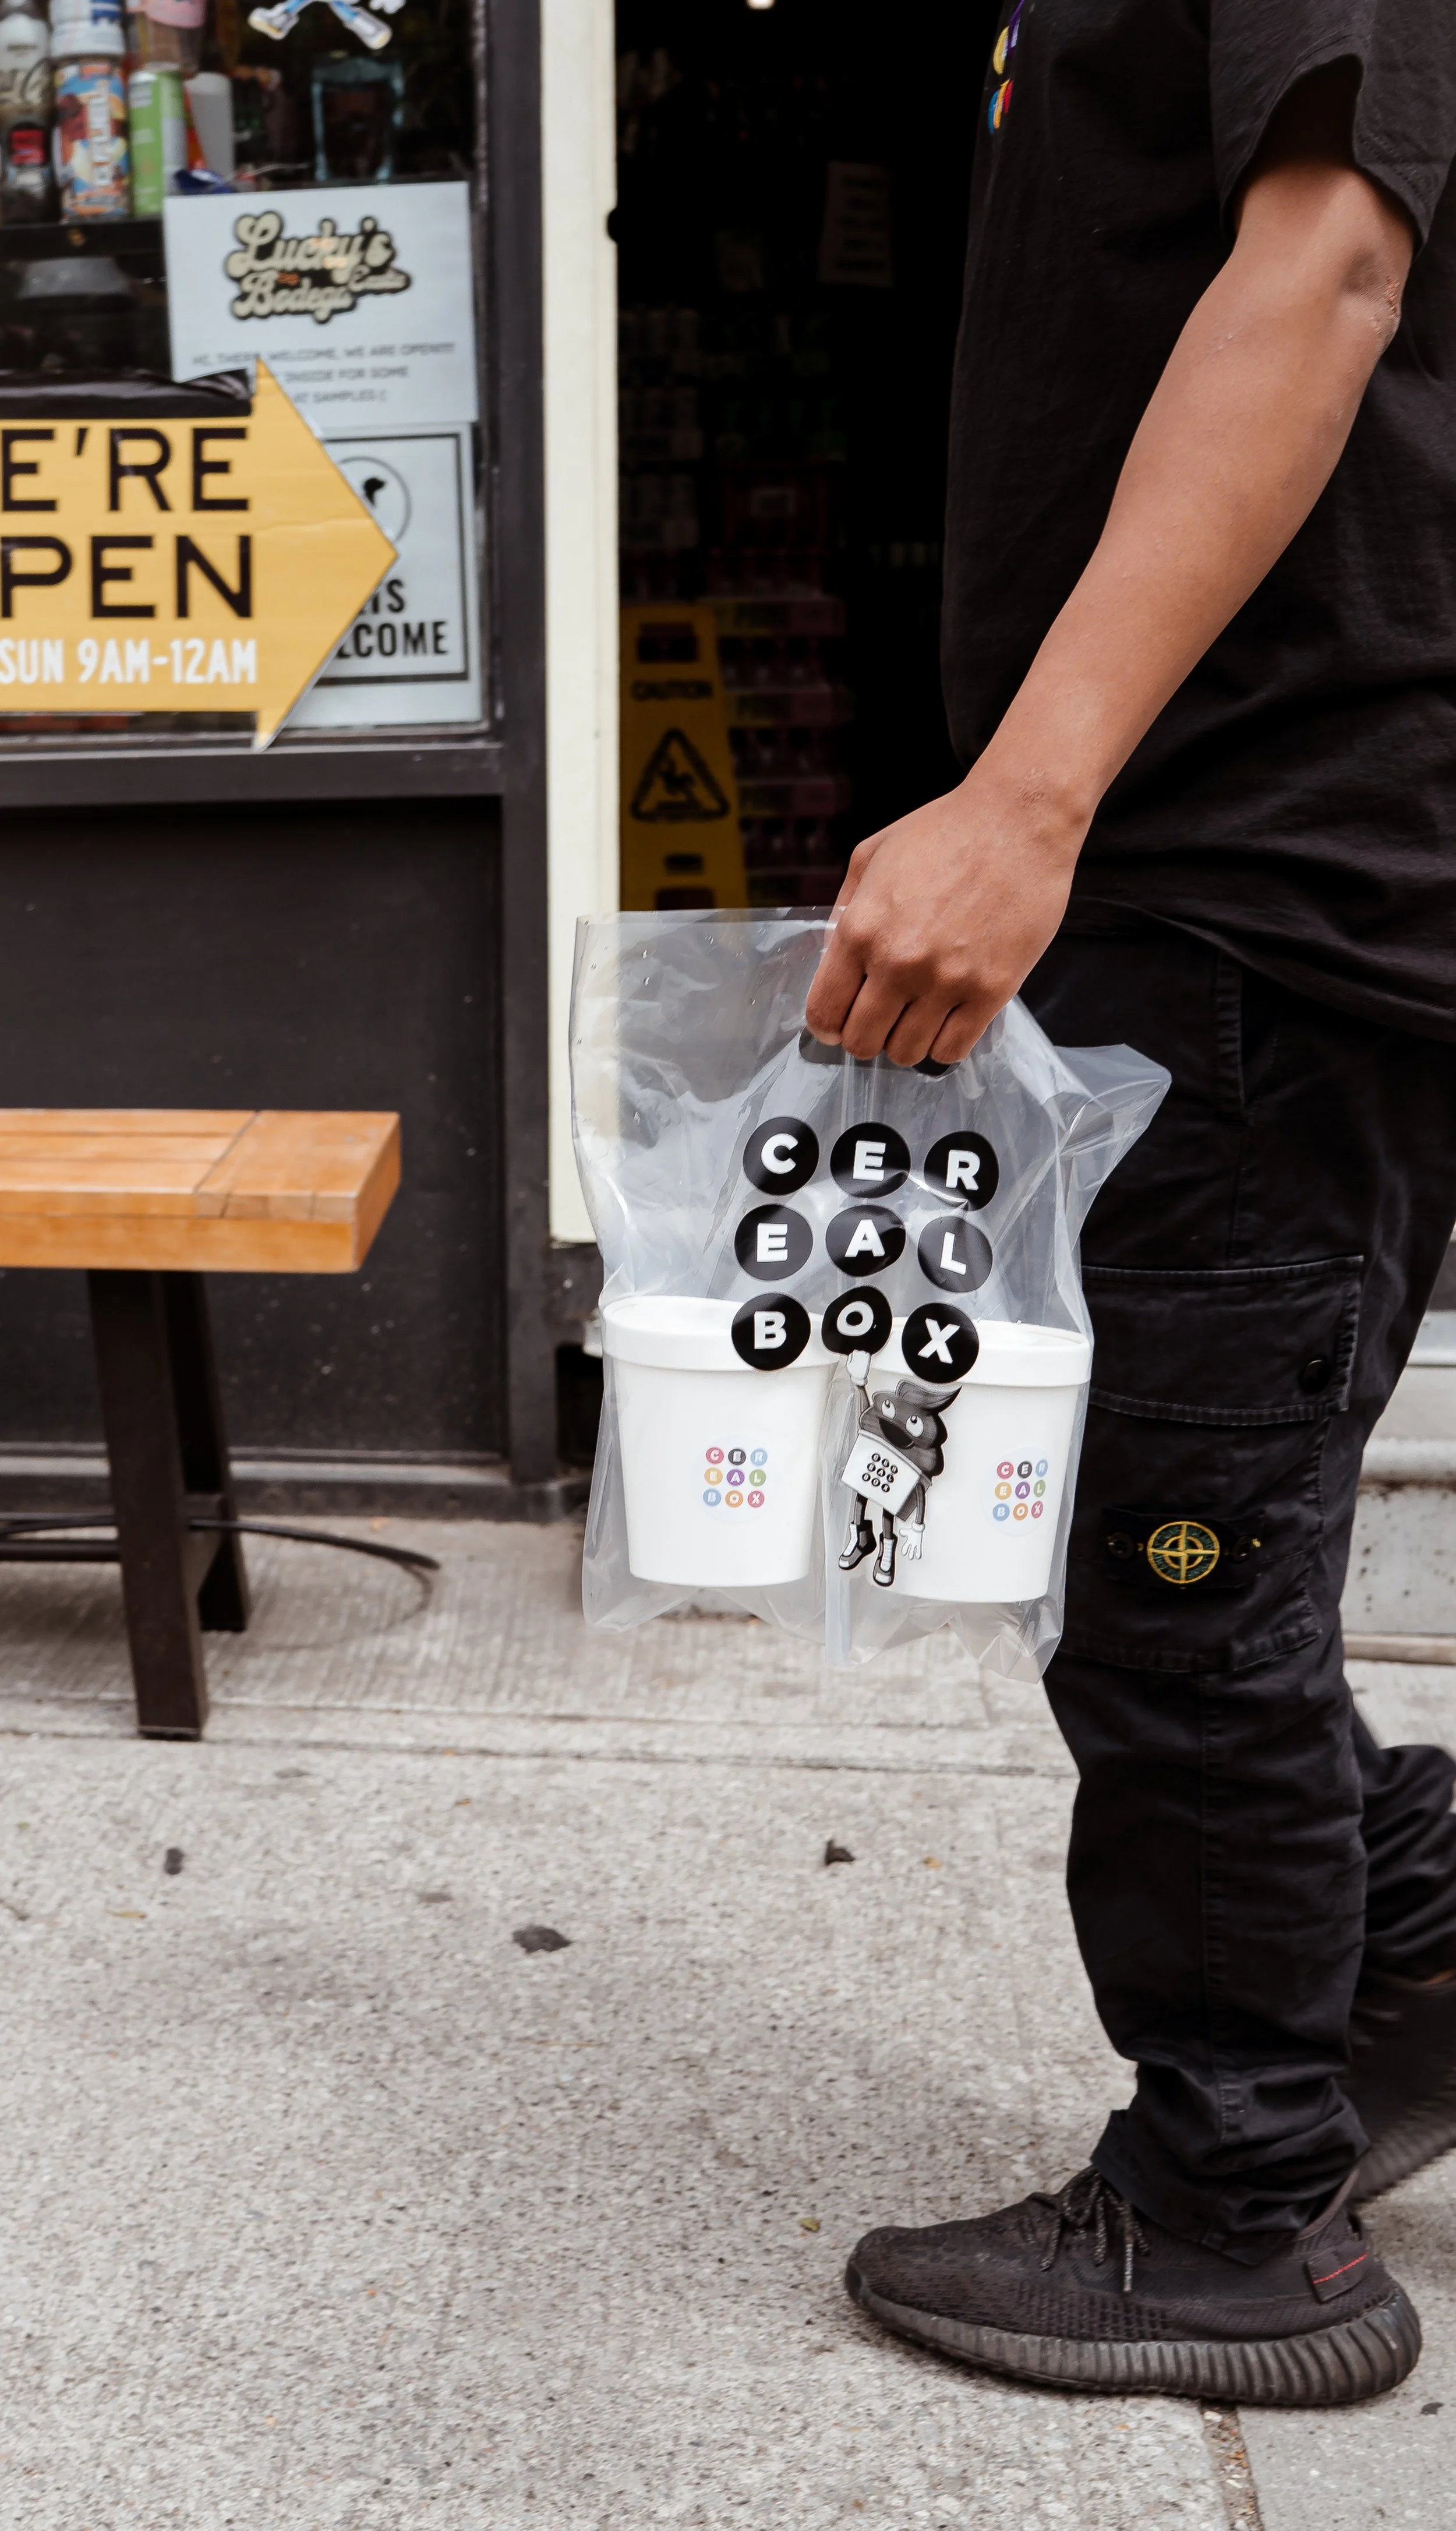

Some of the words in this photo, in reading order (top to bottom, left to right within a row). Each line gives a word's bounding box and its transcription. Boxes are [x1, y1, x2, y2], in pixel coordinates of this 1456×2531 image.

[226, 210, 397, 285] Lucky's
[232, 267, 356, 323] Bodega
[339, 368, 365, 379] FOR
[372, 365, 408, 379] SOME
[0, 637, 64, 683] SUN
[77, 637, 257, 684] 9AM-12AM
[632, 679, 713, 701] CAUTION
[754, 1300, 960, 1364] BOX
